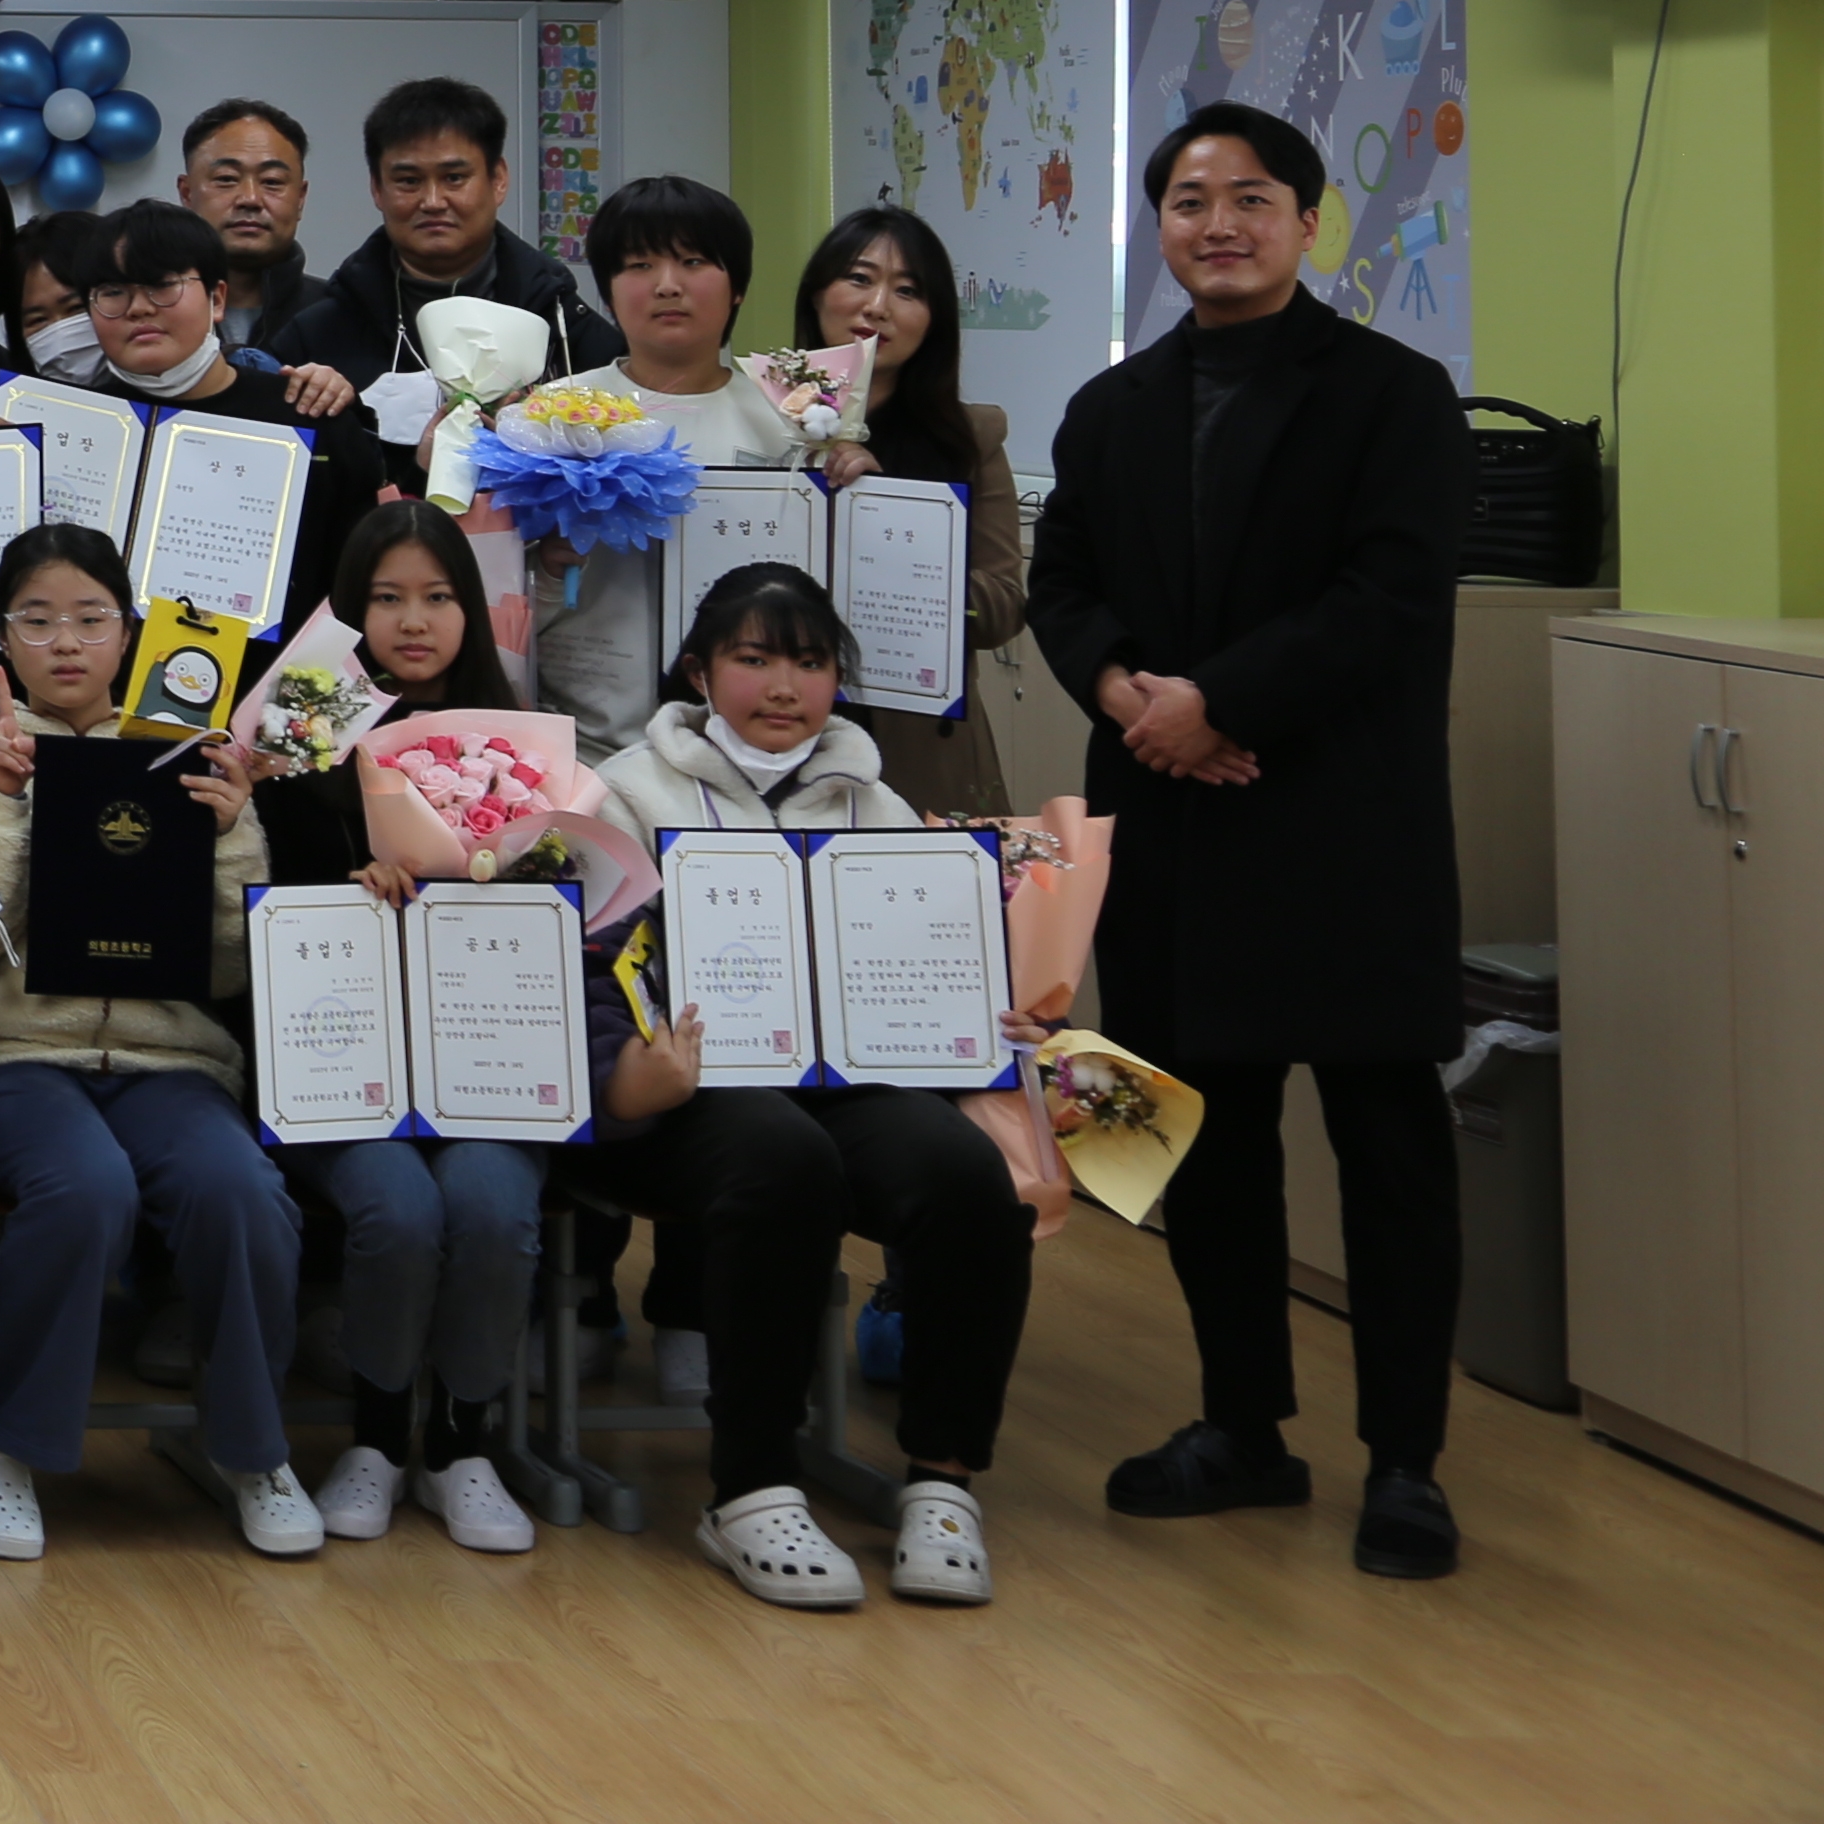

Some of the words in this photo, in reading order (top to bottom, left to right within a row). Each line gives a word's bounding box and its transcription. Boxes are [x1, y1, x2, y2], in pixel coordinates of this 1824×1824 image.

[1338, 11, 1364, 82] K
[1311, 114, 1335, 163] N
[1405, 107, 1422, 160] P
[1354, 122, 1392, 195] O
[1353, 257, 1374, 325] S
[41, 428, 95, 454] 업장
[713, 518, 779, 537] 졸업장
[705, 886, 762, 906] 졸업장
[295, 939, 355, 960] 졸업장
